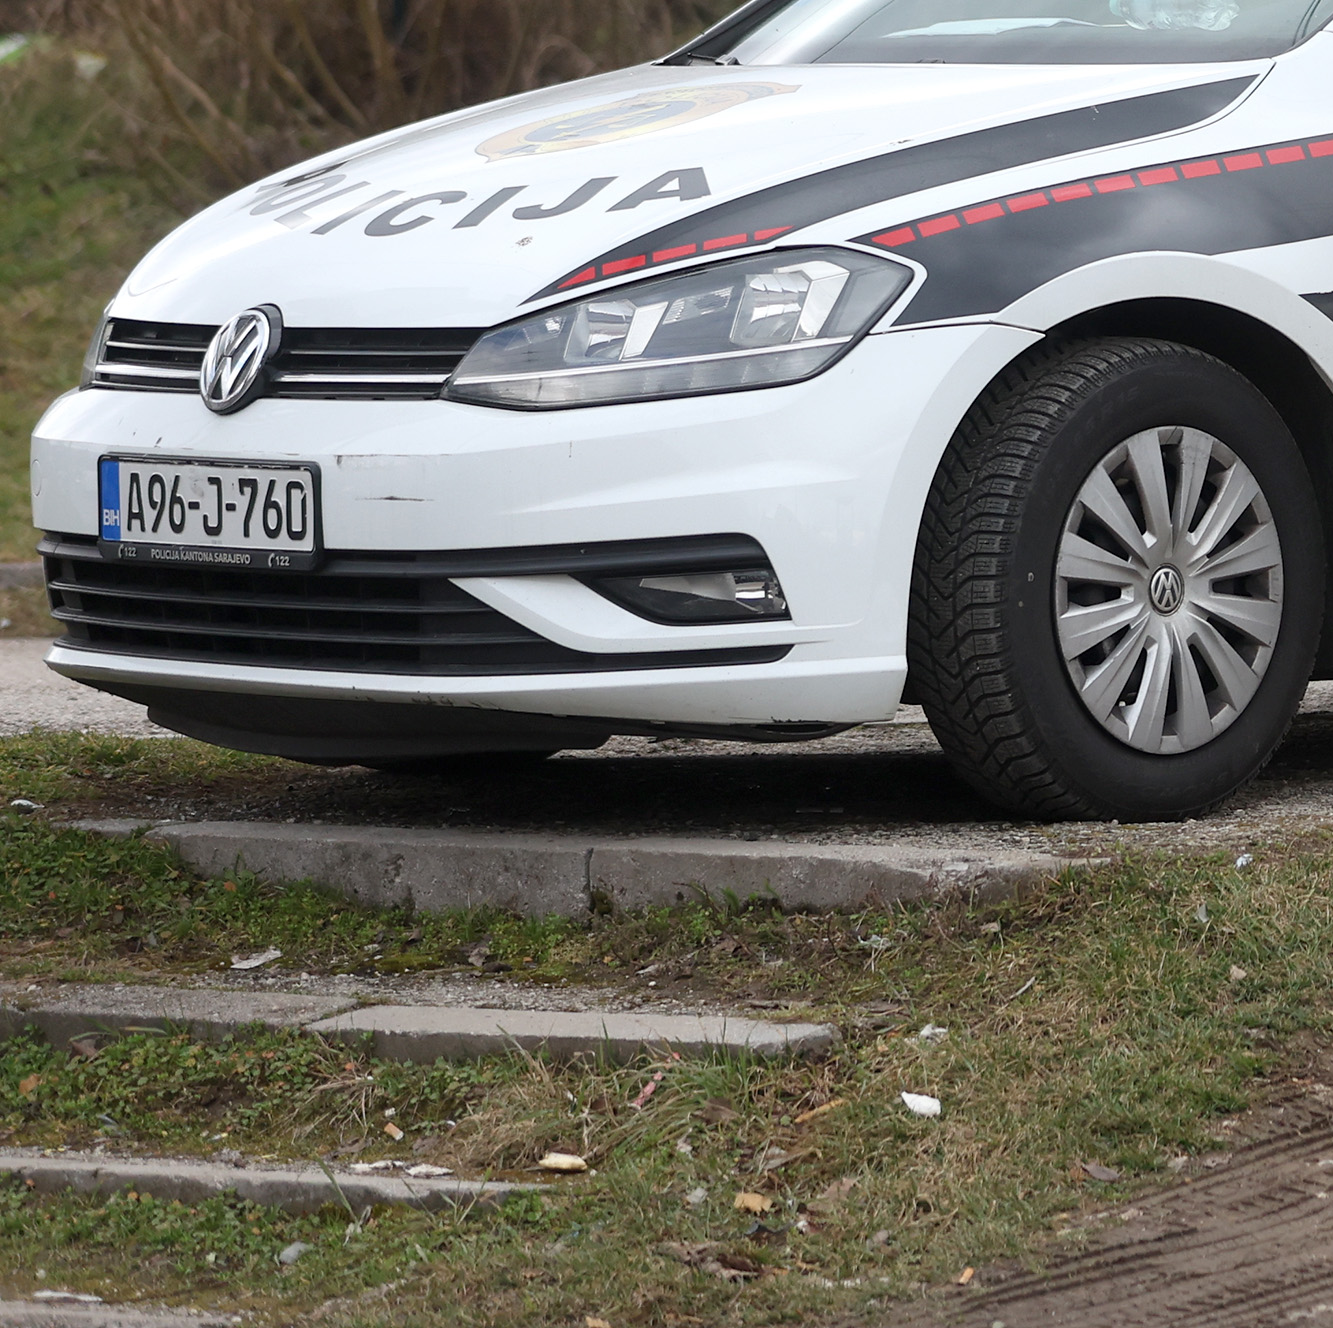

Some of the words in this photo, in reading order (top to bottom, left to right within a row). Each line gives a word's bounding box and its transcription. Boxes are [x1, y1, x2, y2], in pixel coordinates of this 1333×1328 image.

[250, 160, 712, 237] POLICIJA
[103, 509, 120, 526] BIH
[127, 472, 308, 541] A96-J-760
[124, 547, 137, 557] 122
[151, 549, 180, 561] POLICIJA
[180, 550, 214, 562] KANTONA
[214, 552, 251, 564] SARAJEVO
[275, 555, 290, 566] 122
